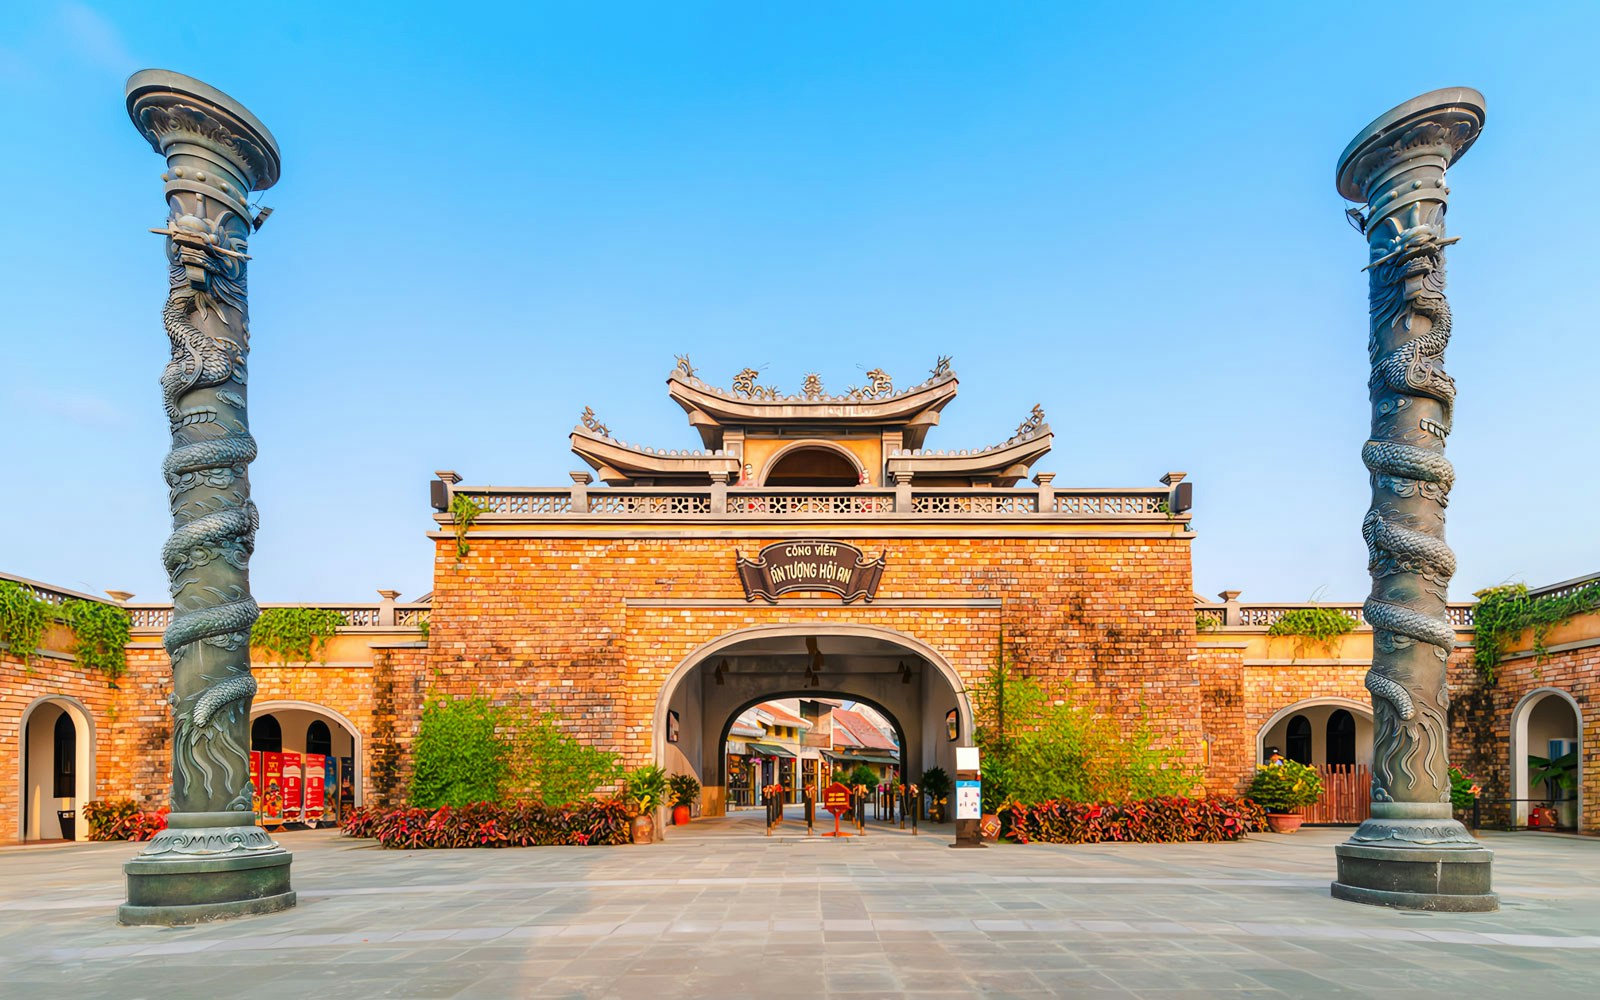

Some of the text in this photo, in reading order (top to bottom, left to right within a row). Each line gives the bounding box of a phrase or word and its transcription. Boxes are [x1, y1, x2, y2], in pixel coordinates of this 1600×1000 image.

[785, 544, 837, 556] CÔNG VIÊN
[770, 563, 786, 584] ẤN
[784, 560, 817, 582] TƯỢNG
[836, 566, 852, 585] AN
